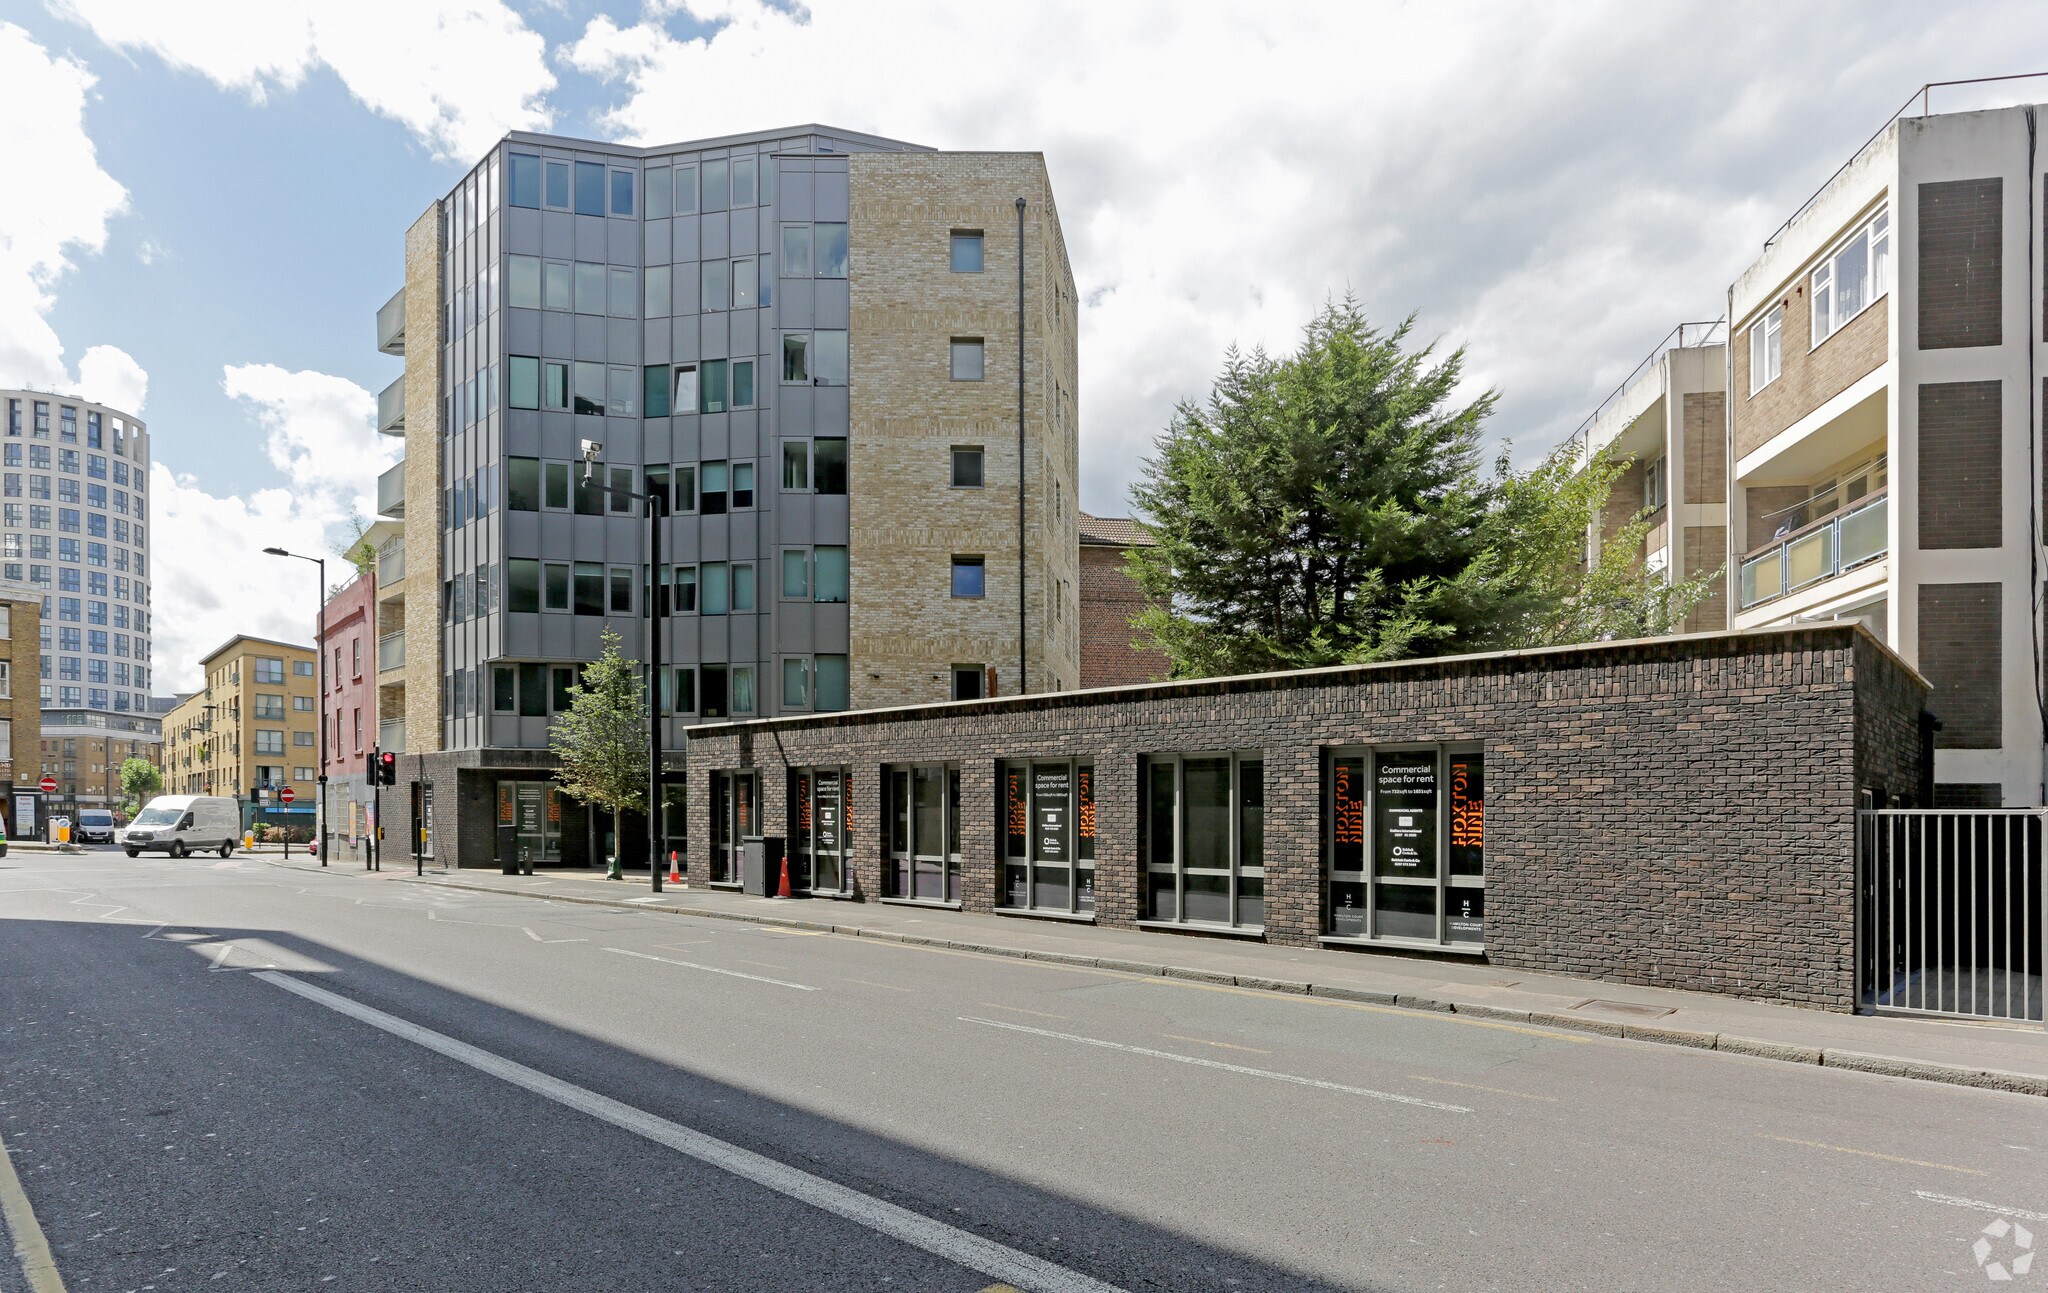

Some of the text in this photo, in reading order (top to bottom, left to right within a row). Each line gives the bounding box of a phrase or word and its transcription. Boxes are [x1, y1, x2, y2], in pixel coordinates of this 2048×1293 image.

[1379, 775, 1434, 785] space for rent
[1382, 765, 1431, 774] Commercial
[1009, 775, 1018, 836] HOXTON
[1080, 773, 1089, 837] HOXTON
[1336, 767, 1349, 843] HOXTON
[1350, 800, 1362, 843] NINE
[1452, 764, 1467, 847] HOXTON
[1467, 800, 1483, 848] NINE
